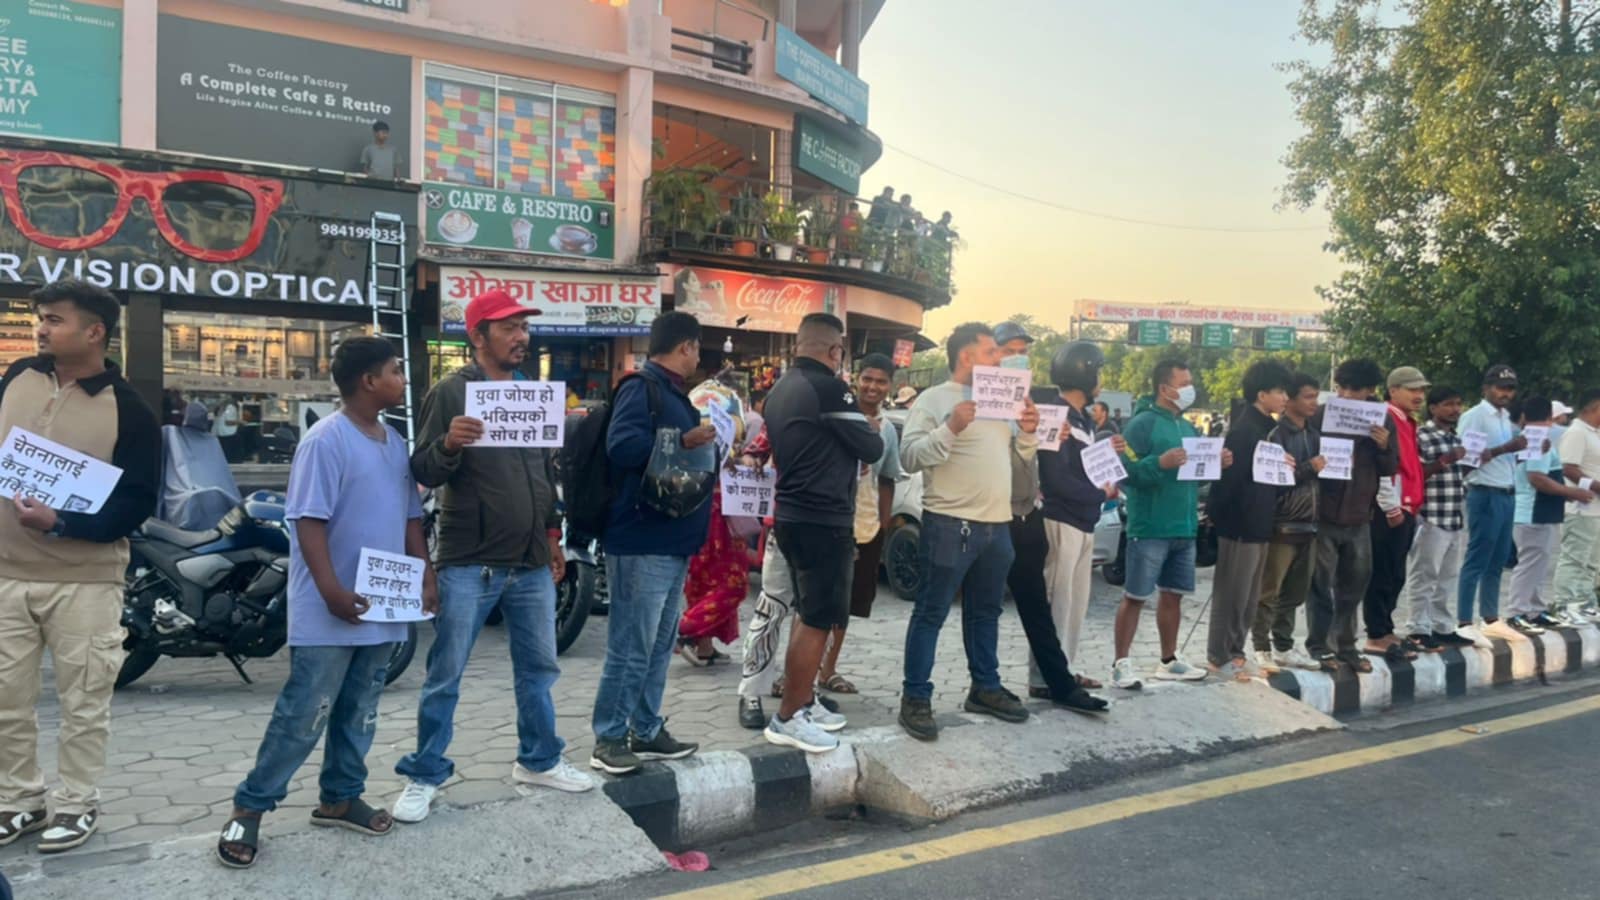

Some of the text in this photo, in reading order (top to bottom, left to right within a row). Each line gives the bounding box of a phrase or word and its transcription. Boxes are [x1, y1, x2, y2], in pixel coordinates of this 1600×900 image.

[0, 77, 38, 96] TA
[228, 63, 348, 91] The Coffee Factory
[180, 73, 391, 114] A Complete Cafe & Restro
[196, 93, 215, 102] Life
[218, 95, 251, 107] Begins
[254, 101, 278, 111] After
[281, 105, 313, 116] Coffee
[449, 190, 593, 223] CAFE & RESTRO
[36, 255, 196, 294] VISION
[540, 280, 614, 304] खाजा
[618, 283, 657, 305] घर
[475, 384, 554, 405] युवा जोश हो
[489, 426, 538, 443] सोच हो
[1, 453, 62, 487] कैद गर्न
[14, 435, 88, 480] चेतनालाई
[726, 483, 739, 496] को
[367, 556, 384, 571] युवा
